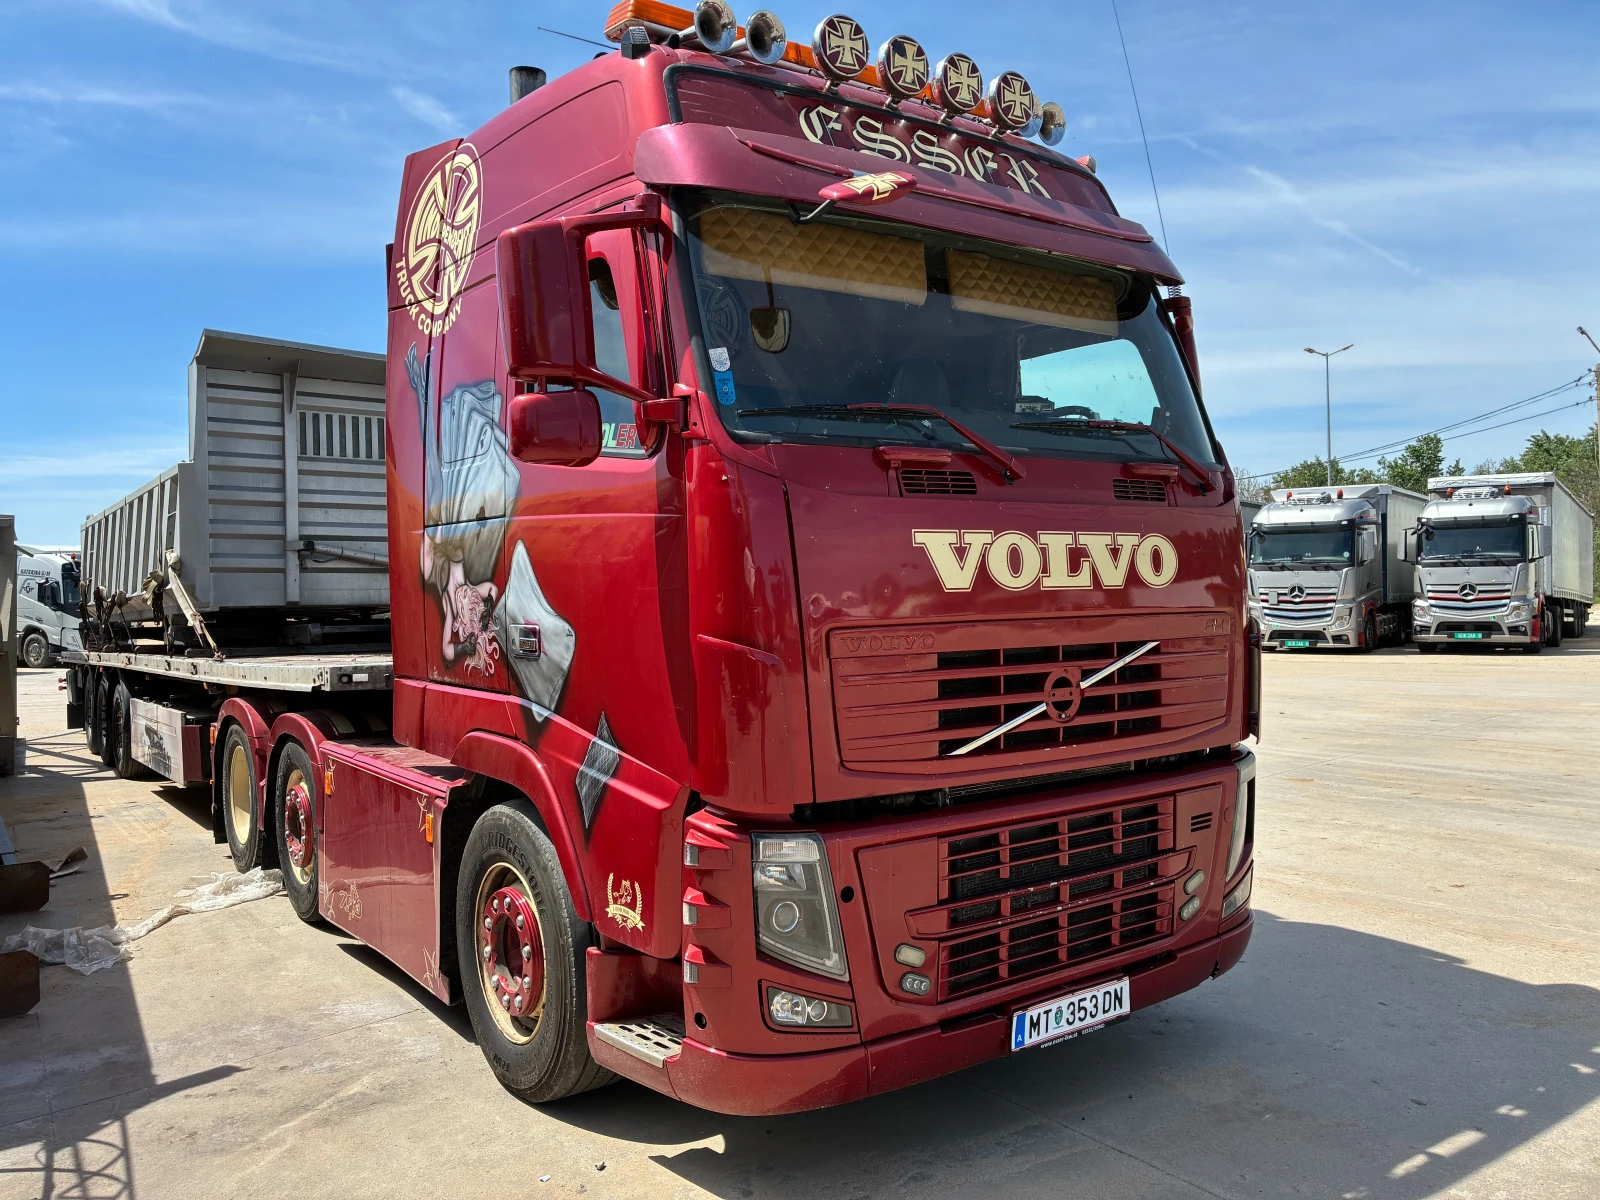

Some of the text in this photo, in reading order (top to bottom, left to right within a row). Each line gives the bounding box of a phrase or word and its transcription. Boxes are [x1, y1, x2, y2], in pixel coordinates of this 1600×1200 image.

[798, 105, 1052, 199] ESSER
[396, 262, 462, 337] TRUCK COMPANY
[911, 529, 1178, 592] VOLVO
[842, 633, 936, 653] VOLVO
[481, 832, 547, 922] BRIDGESTONE
[1016, 986, 1123, 1042] A MT 353 DN
